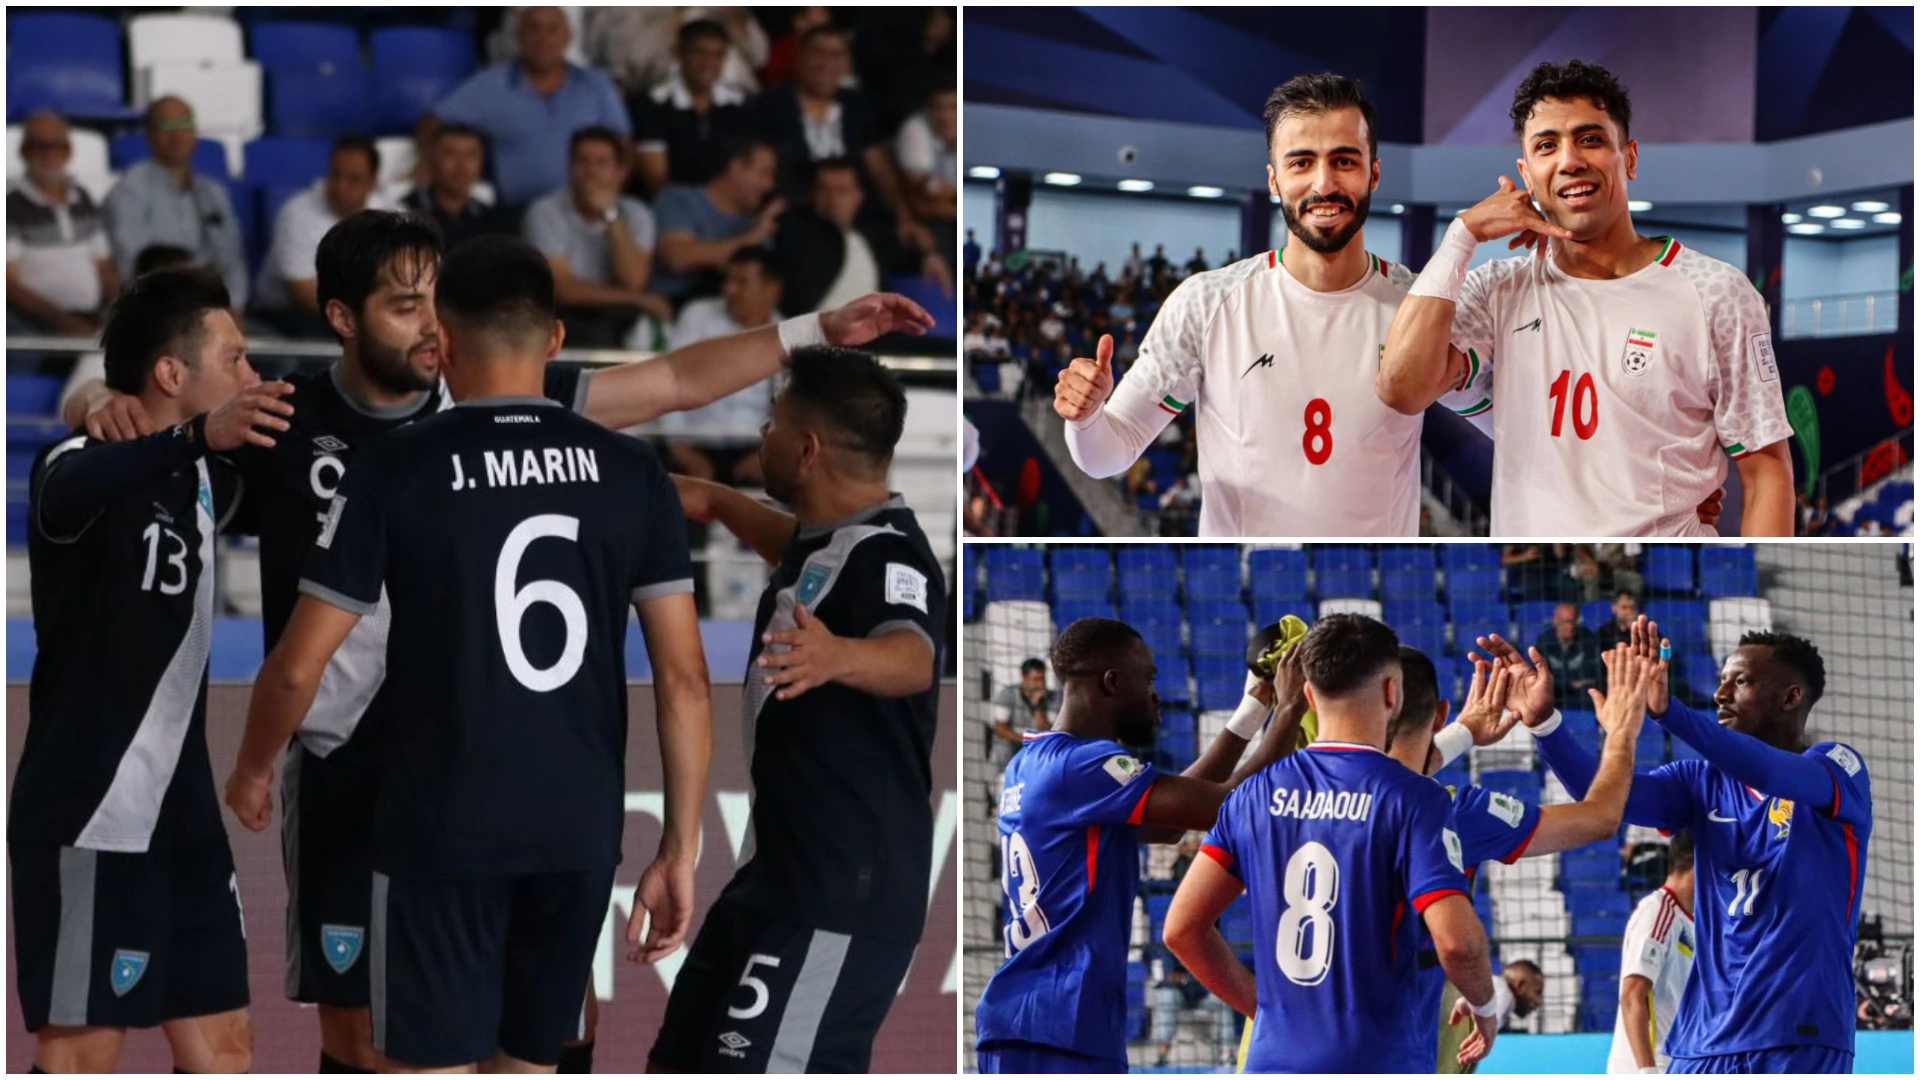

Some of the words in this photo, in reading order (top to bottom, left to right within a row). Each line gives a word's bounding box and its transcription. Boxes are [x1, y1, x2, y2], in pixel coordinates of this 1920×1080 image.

[494, 414, 541, 424] GUATEMALA
[1302, 397, 1333, 466] 8
[1549, 369, 1599, 441] 10
[451, 453, 477, 492] J.
[483, 446, 600, 488] MARIN
[141, 522, 188, 594] 13
[494, 513, 588, 692] 6
[1269, 787, 1373, 822] SAADAOUI
[1275, 840, 1340, 987] 8
[1727, 868, 1764, 917] 11
[727, 952, 781, 1020] 5
